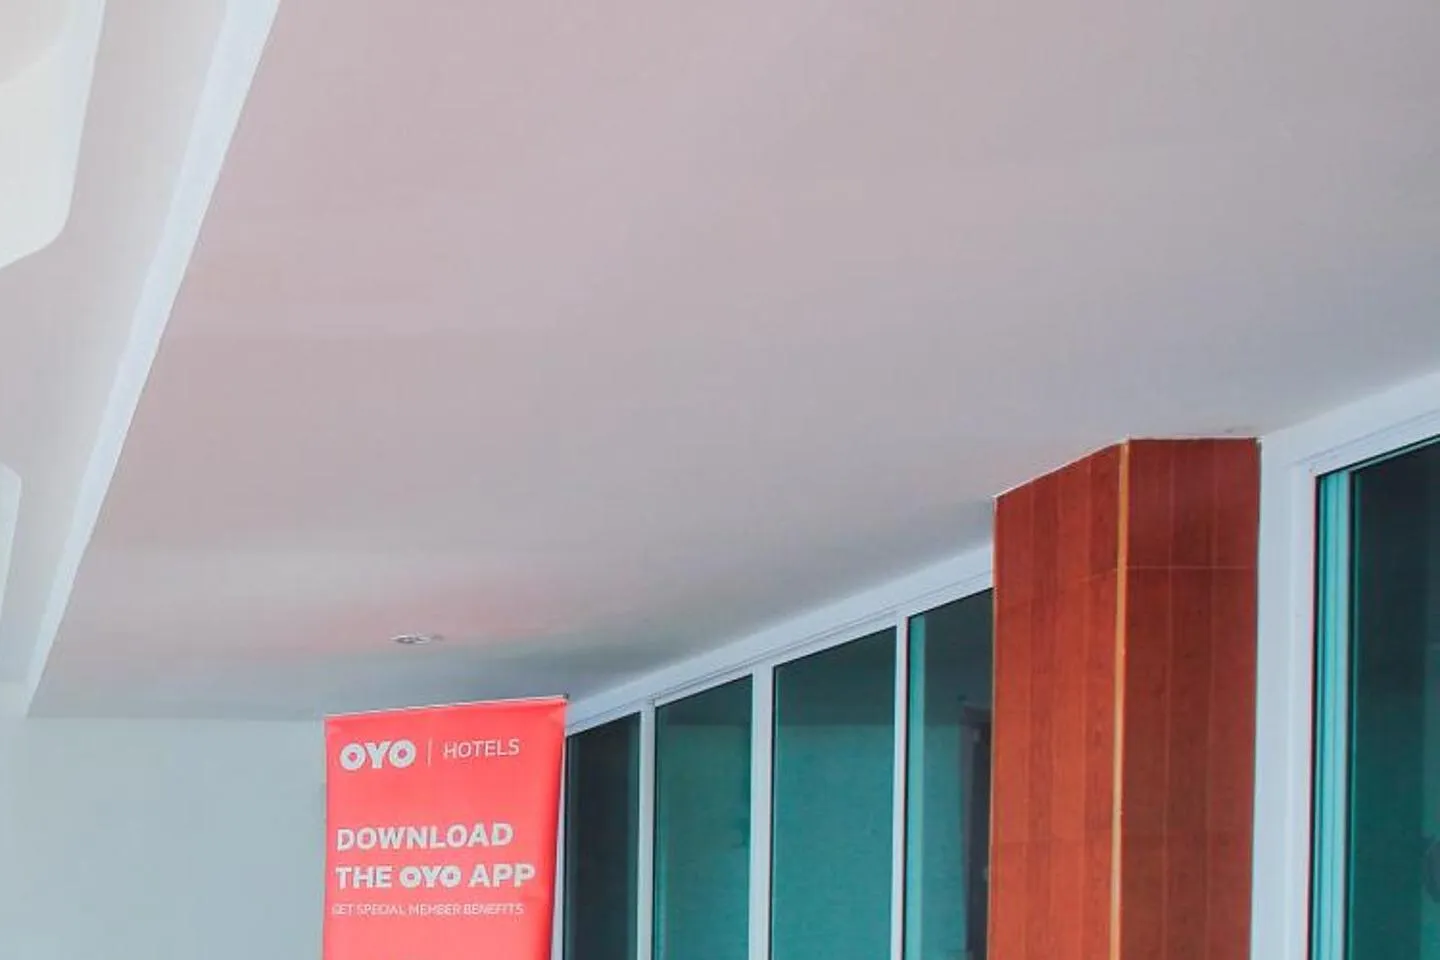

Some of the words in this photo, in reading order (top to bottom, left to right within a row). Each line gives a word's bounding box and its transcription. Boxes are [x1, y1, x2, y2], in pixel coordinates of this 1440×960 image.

[340, 739, 416, 770] OYO
[443, 738, 520, 760] HOTELS
[336, 823, 514, 851] DOWNLOAD
[335, 865, 393, 889] THE
[399, 865, 461, 889] OYO
[468, 863, 536, 888] APP
[332, 903, 354, 916] GET
[358, 903, 405, 916] SPECIAL
[409, 903, 460, 916] MEMBER
[464, 902, 524, 916] BENEFITS
